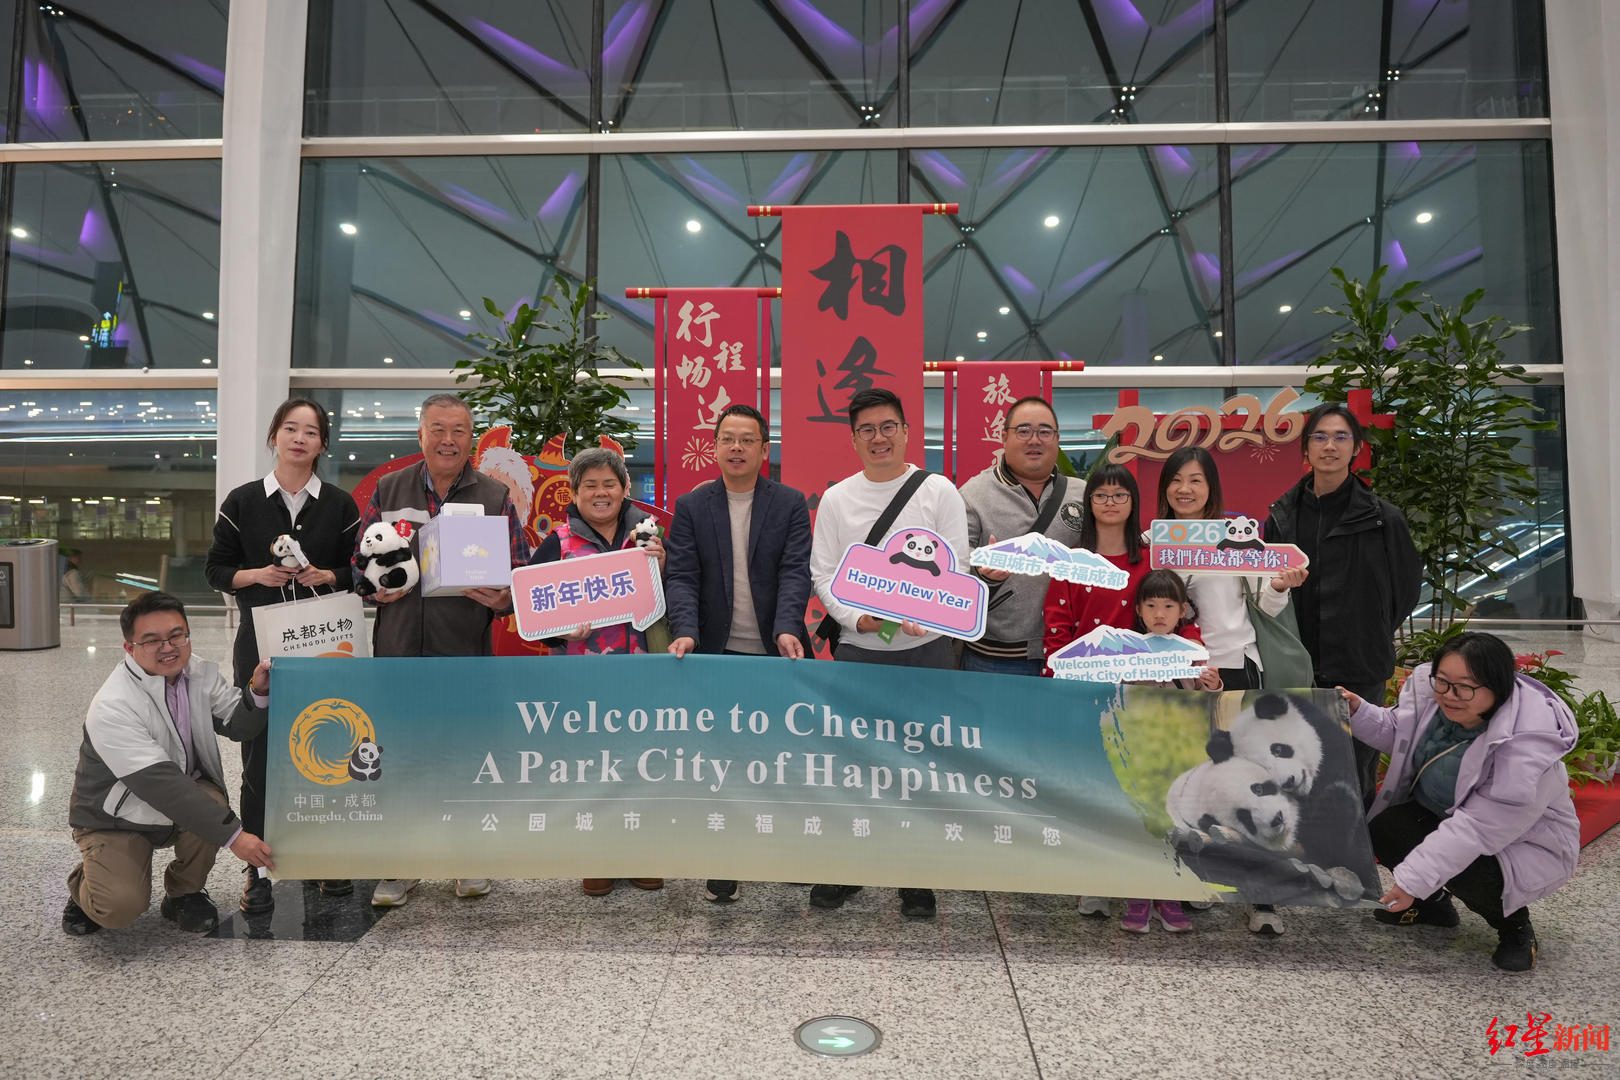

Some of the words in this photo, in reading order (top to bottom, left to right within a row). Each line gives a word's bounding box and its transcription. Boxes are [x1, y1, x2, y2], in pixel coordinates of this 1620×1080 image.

[1102, 386, 1305, 464] 2026
[1154, 523, 1221, 543] 2026
[531, 570, 635, 612] 新年快乐
[847, 568, 897, 593] Happy
[899, 582, 934, 600] New
[937, 590, 973, 609] Year
[282, 618, 353, 643] 成都礼物
[283, 639, 326, 651] CHENGDU
[330, 633, 354, 642] GIFTS
[1053, 658, 1110, 670] Welcome
[1113, 657, 1126, 667] to
[1129, 652, 1190, 667] Chengdu,
[1065, 669, 1093, 682] Park
[1096, 670, 1122, 682] City
[1125, 668, 1137, 680] of
[515, 701, 715, 735] Welcome
[729, 703, 769, 734] to
[785, 702, 983, 753] Chengdu
[472, 751, 504, 784] A
[516, 748, 623, 784] Park
[637, 747, 732, 792] City
[747, 751, 793, 785] of
[803, 752, 1038, 800] Happiness
[286, 810, 346, 823] Chengdu,
[348, 810, 384, 822] China
